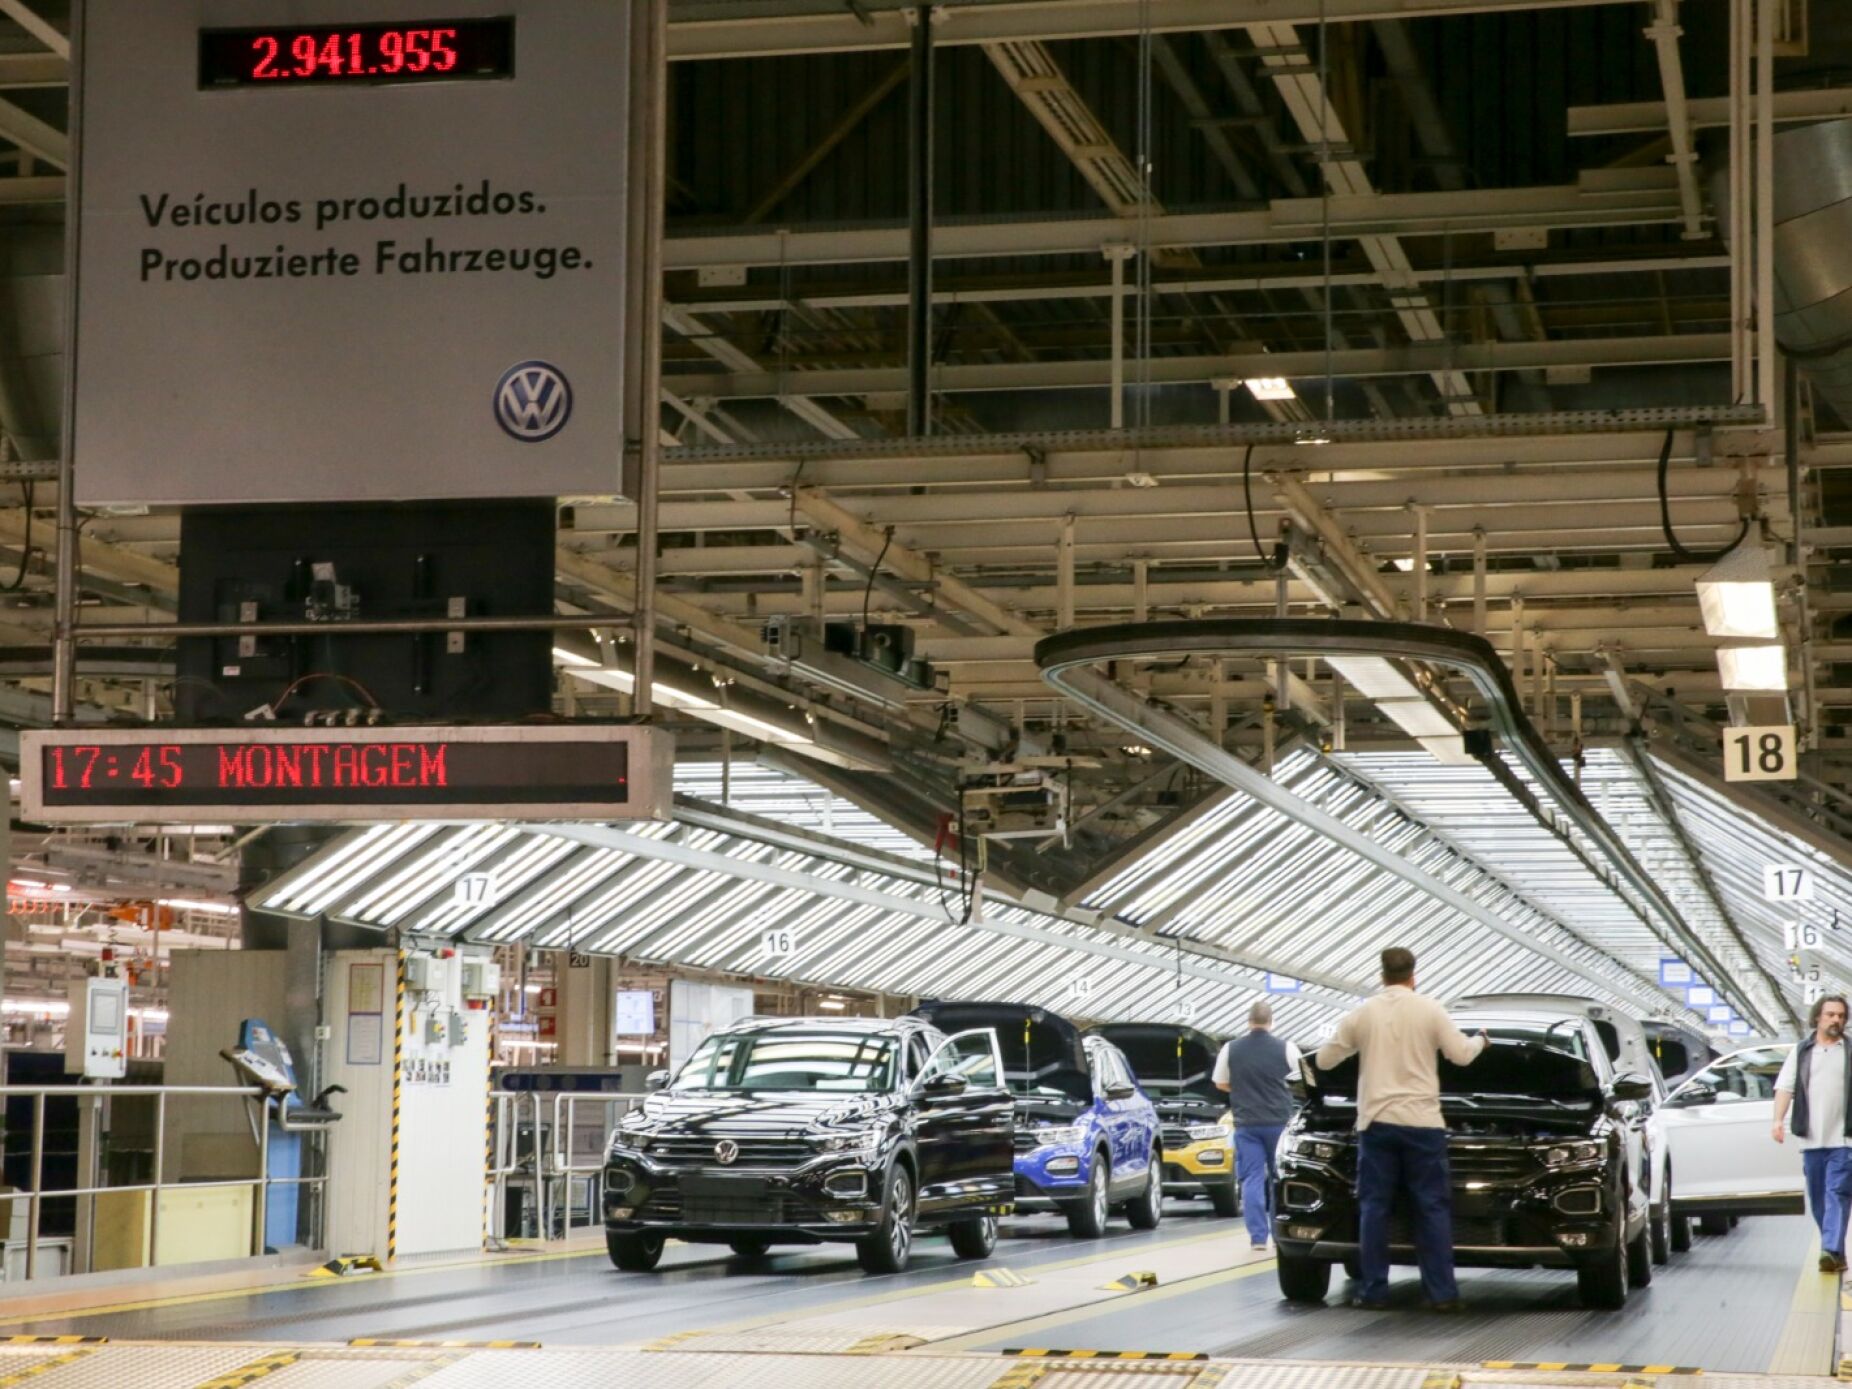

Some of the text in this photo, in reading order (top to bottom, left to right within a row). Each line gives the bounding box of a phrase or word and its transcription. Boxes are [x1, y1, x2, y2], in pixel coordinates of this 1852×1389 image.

[252, 29, 457, 78] 2.941.955
[139, 180, 546, 230] Veículos produzidos.
[139, 238, 593, 282] Produzierte Fahrzeuge.
[497, 363, 571, 439] VW
[52, 743, 448, 788] 17:45 MONTAGEM
[1734, 733, 1784, 773] 18
[463, 877, 489, 902] 17
[1773, 869, 1803, 896] 17
[768, 932, 789, 953] 16
